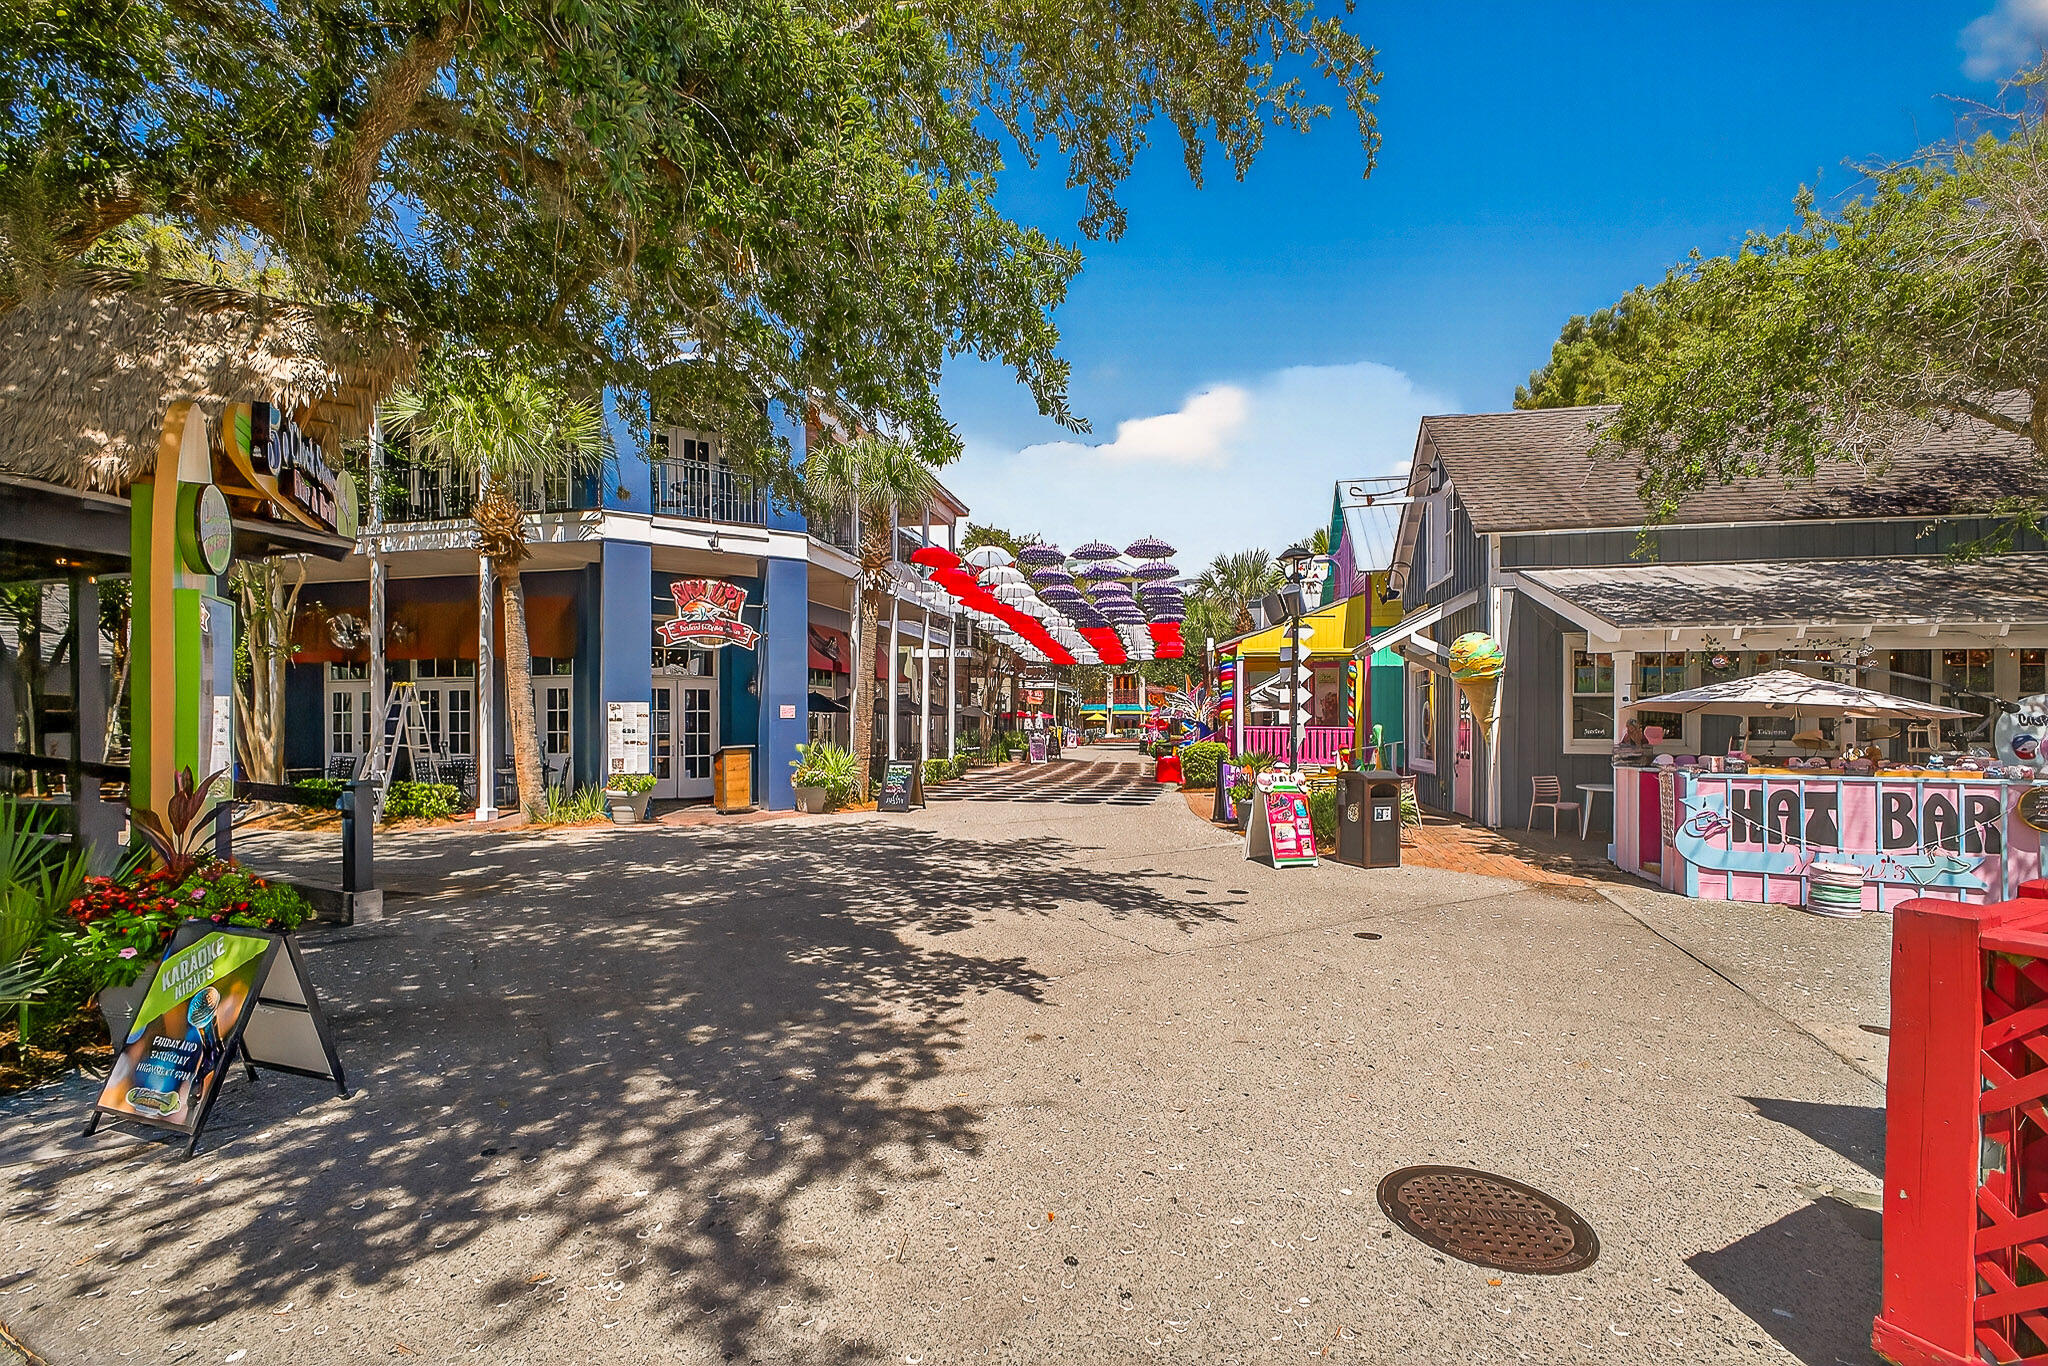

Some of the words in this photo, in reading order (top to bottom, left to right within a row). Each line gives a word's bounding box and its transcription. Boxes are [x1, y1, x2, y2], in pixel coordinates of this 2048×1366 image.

[1731, 788, 1838, 849] HAT
[1881, 791, 2002, 855] BAR
[162, 935, 226, 992] KARAOKE
[150, 1050, 190, 1066] SATURDAY
[152, 1035, 181, 1049] FRIDAY
[179, 1040, 198, 1053] AND
